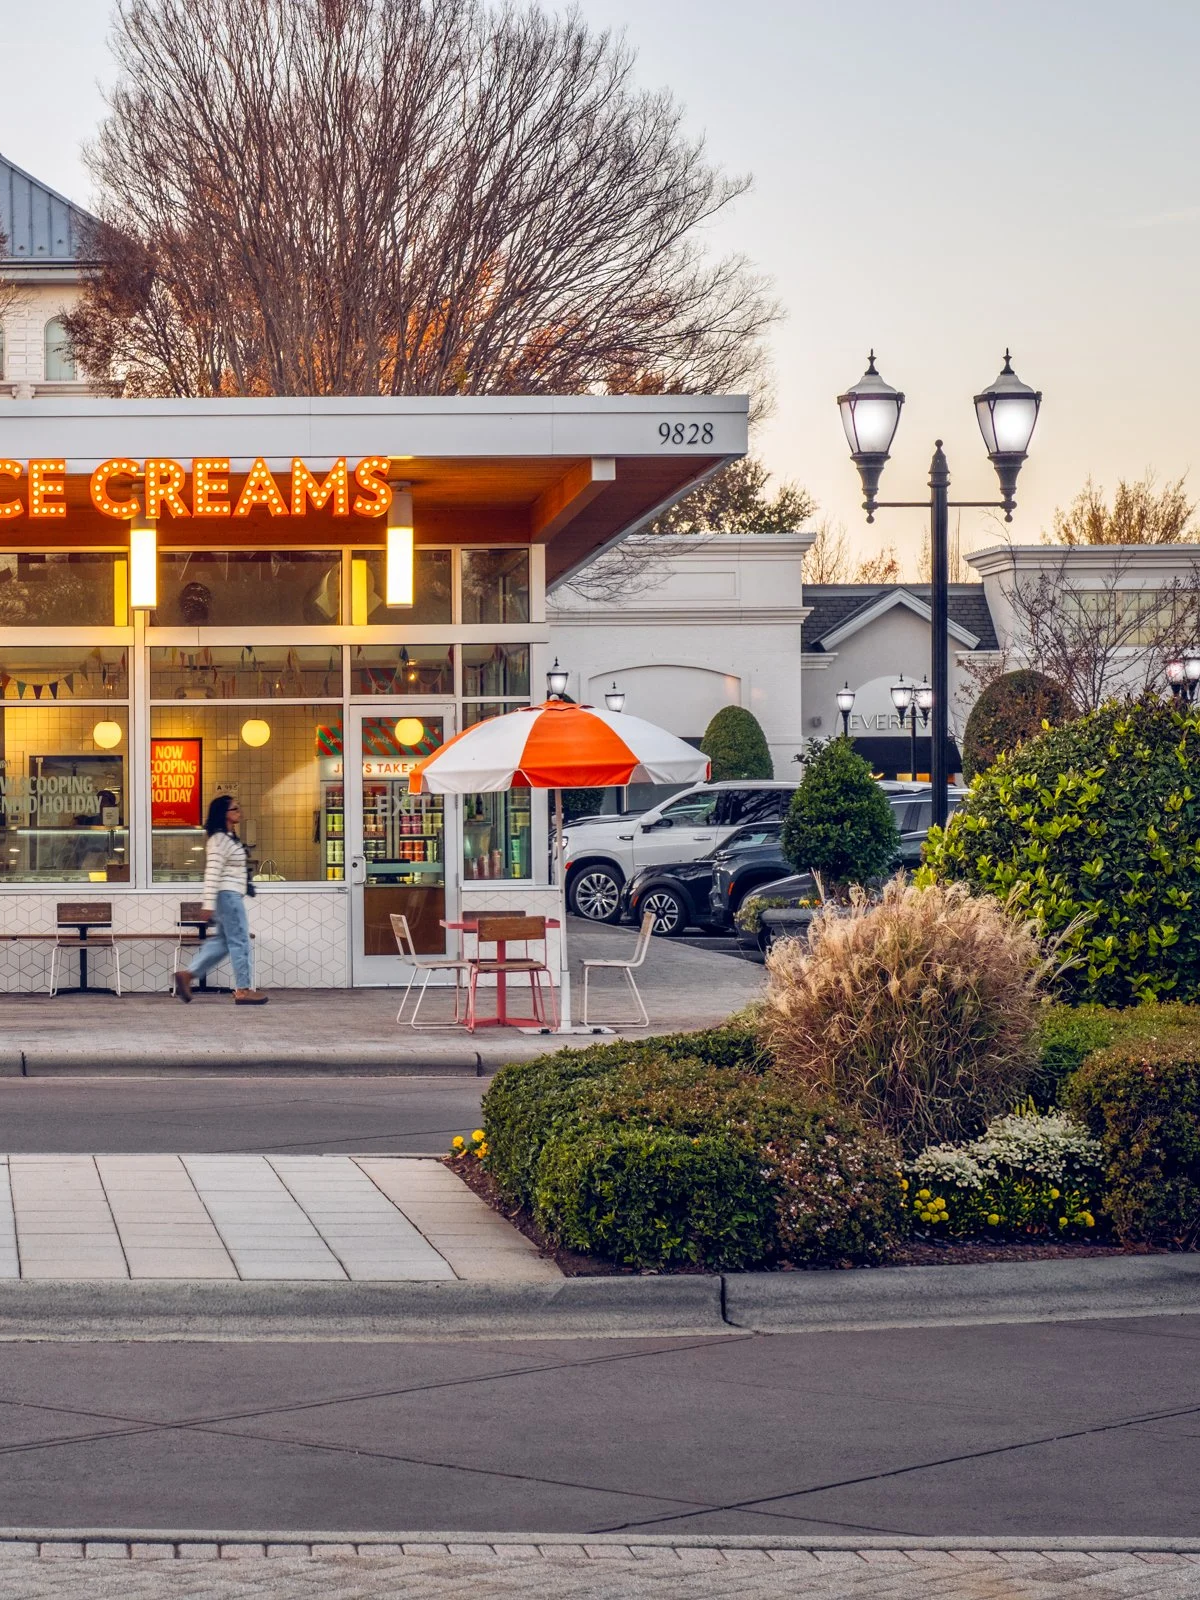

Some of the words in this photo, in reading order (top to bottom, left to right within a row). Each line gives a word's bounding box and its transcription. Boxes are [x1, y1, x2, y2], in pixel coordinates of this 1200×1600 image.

[658, 422, 714, 445] 9828
[90, 456, 393, 519] CREAMS
[155, 745, 184, 759] NOW
[20, 775, 93, 794] SCOOPING
[151, 774, 195, 789] PLENDID
[42, 795, 103, 814] HOLIDAY
[152, 788, 193, 803] OLIDAY
[376, 796, 432, 816] EXIT
